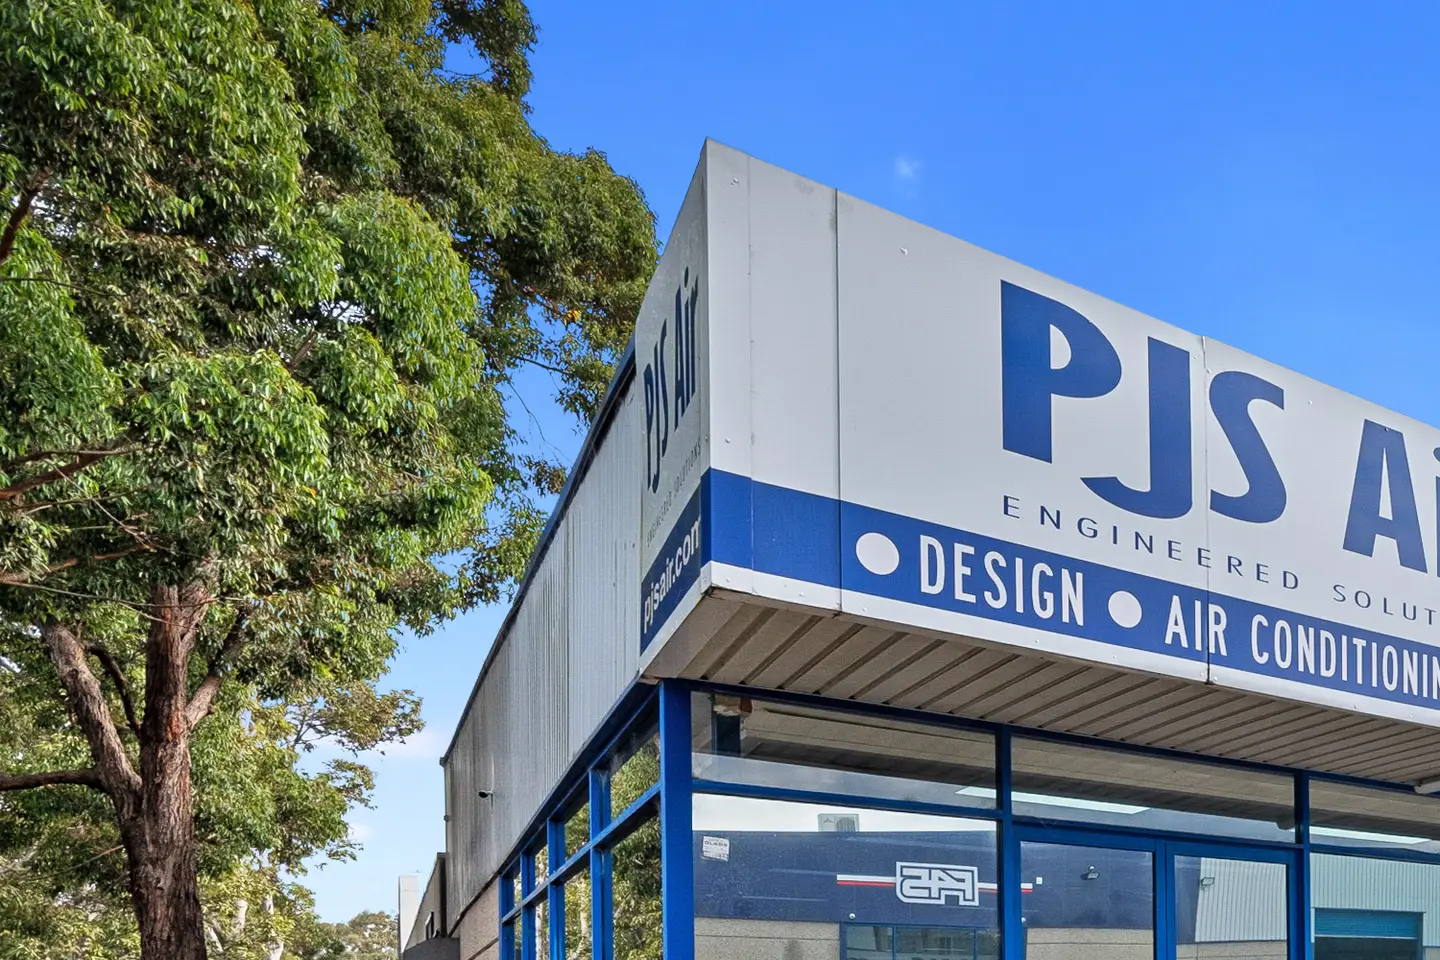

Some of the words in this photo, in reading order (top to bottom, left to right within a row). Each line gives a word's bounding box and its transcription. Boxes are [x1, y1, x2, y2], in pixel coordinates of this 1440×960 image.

[644, 319, 667, 494] PJS
[674, 266, 699, 431] Air
[1001, 280, 1288, 524] PJS
[919, 535, 1085, 625] DESIGN
[1003, 495, 1299, 590] ENGINEERED
[1164, 594, 1227, 657] AIR
